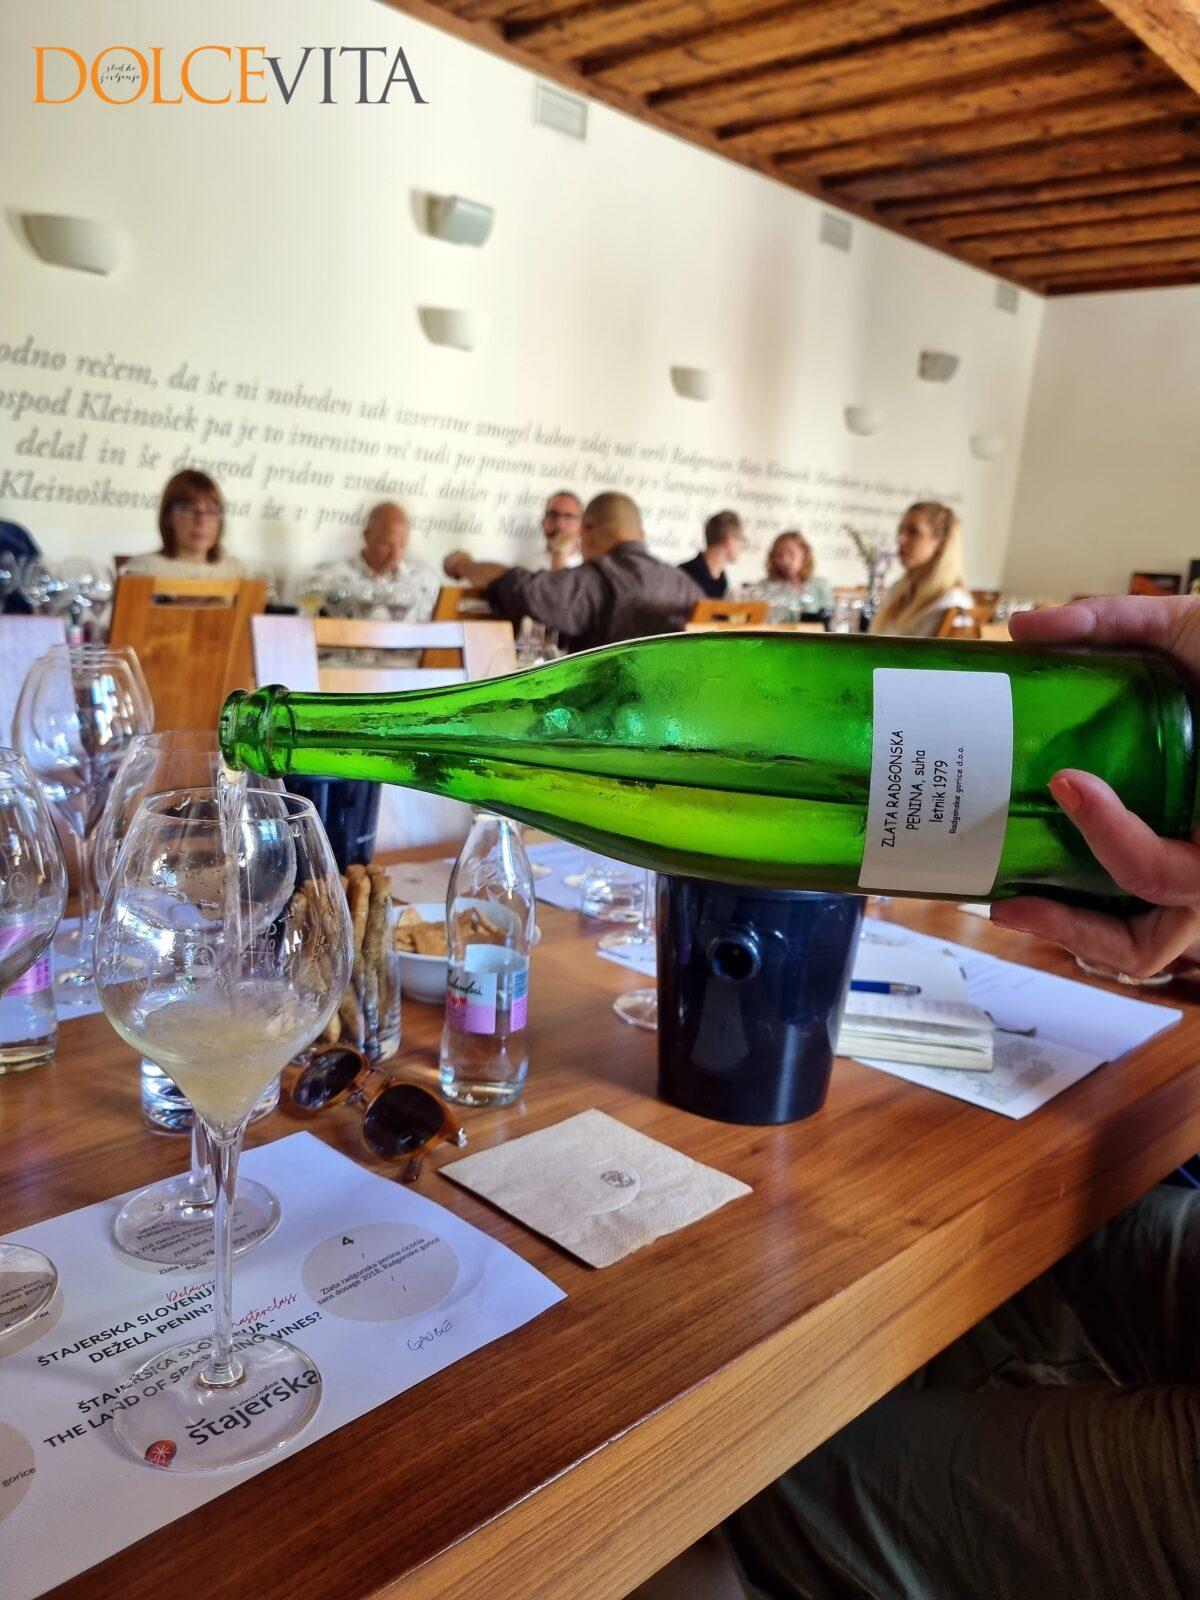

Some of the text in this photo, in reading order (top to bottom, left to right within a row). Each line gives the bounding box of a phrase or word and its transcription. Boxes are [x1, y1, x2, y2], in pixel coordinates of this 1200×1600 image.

[75, 353, 158, 389] rečem,
[167, 362, 200, 392] da
[205, 370, 229, 396] še
[233, 377, 260, 401] ni
[266, 381, 353, 416] nobeden
[358, 394, 390, 421] tak
[77, 390, 198, 432] Kleinošek
[200, 417, 232, 445] pa
[233, 415, 258, 448] je
[262, 424, 285, 444] to
[14, 425, 88, 461] delal
[97, 437, 127, 466] in
[137, 442, 162, 470] še
[260, 460, 335, 490] pridno
[882, 730, 904, 848] ZLATA RADGONSKA
[905, 749, 926, 830] PENINA, suha
[929, 760, 948, 823] letnik 1979
[954, 768, 964, 794] gorice
[949, 794, 961, 834] Radgonske
[342, 1236, 354, 1246] 4
[320, 1281, 341, 1295] Zlata
[341, 1262, 378, 1288] radgonska
[336, 1280, 361, 1296] dosage
[362, 1268, 383, 1283] 2018,
[37, 1320, 137, 1367] ŠTAJERSKA
[88, 1303, 214, 1364] DEŽELA PENIN?
[178, 1321, 268, 1359] SLOIJA
[43, 1424, 87, 1447] THE
[88, 1395, 140, 1428] LAND
[142, 1379, 167, 1397] OF
[185, 1369, 320, 1445] štajerska
[2, 1467, 36, 1487] gorice
